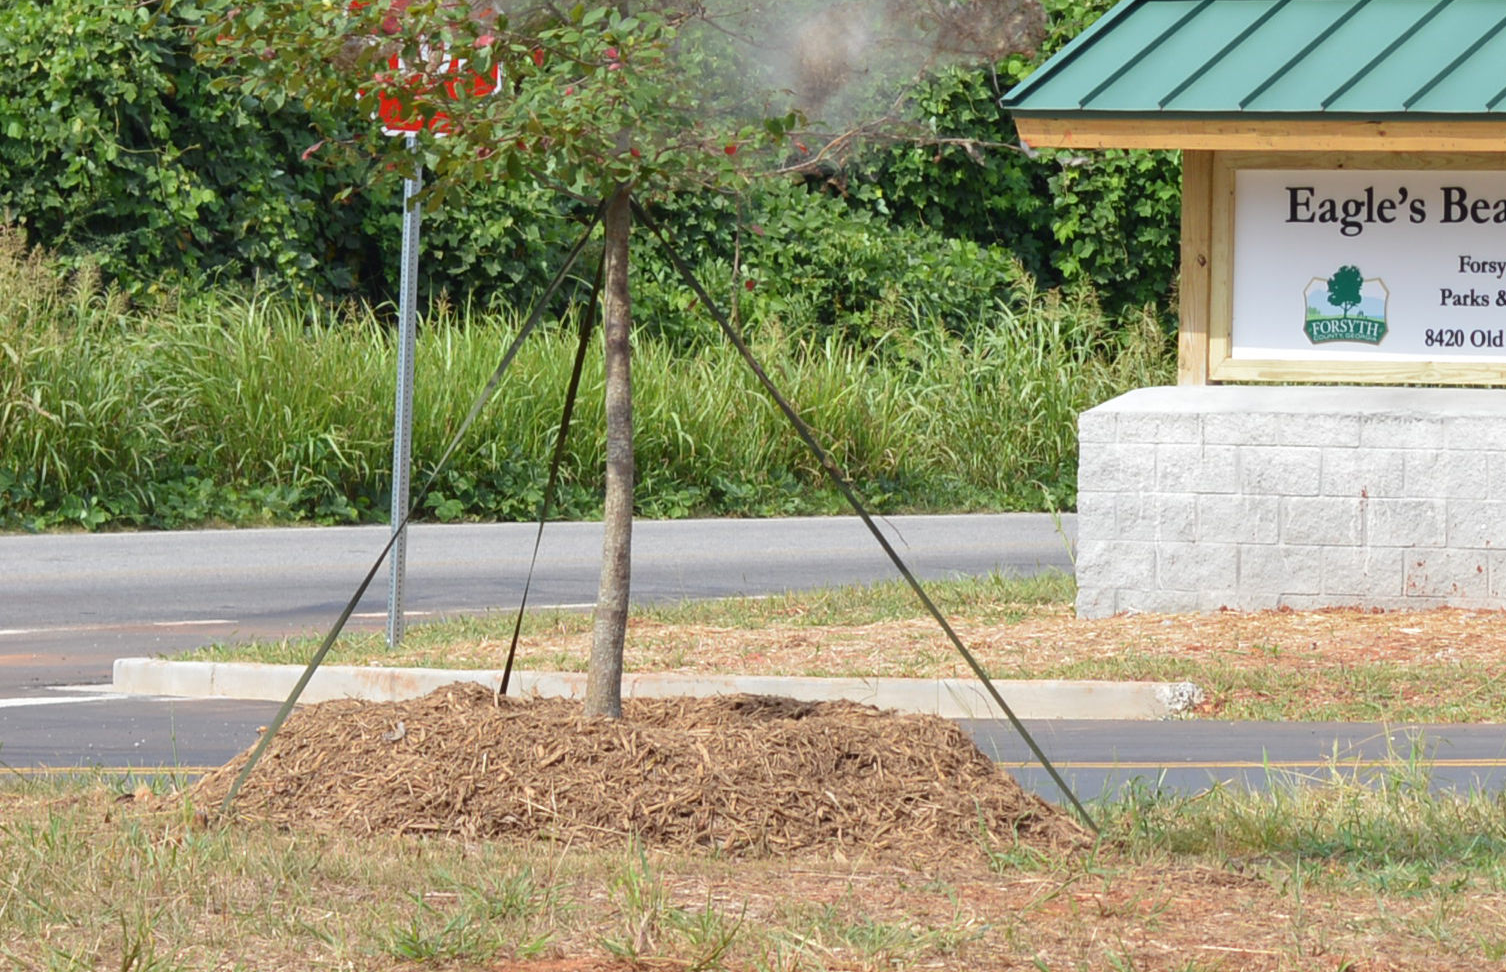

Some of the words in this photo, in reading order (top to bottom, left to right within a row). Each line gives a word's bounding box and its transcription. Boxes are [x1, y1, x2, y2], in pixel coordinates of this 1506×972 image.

[1285, 185, 1426, 237] Eagle's
[1440, 288, 1490, 307] Parks
[1311, 319, 1379, 337] FORSYTH
[1424, 328, 1465, 347] 8420
[1470, 329, 1504, 348] Old
